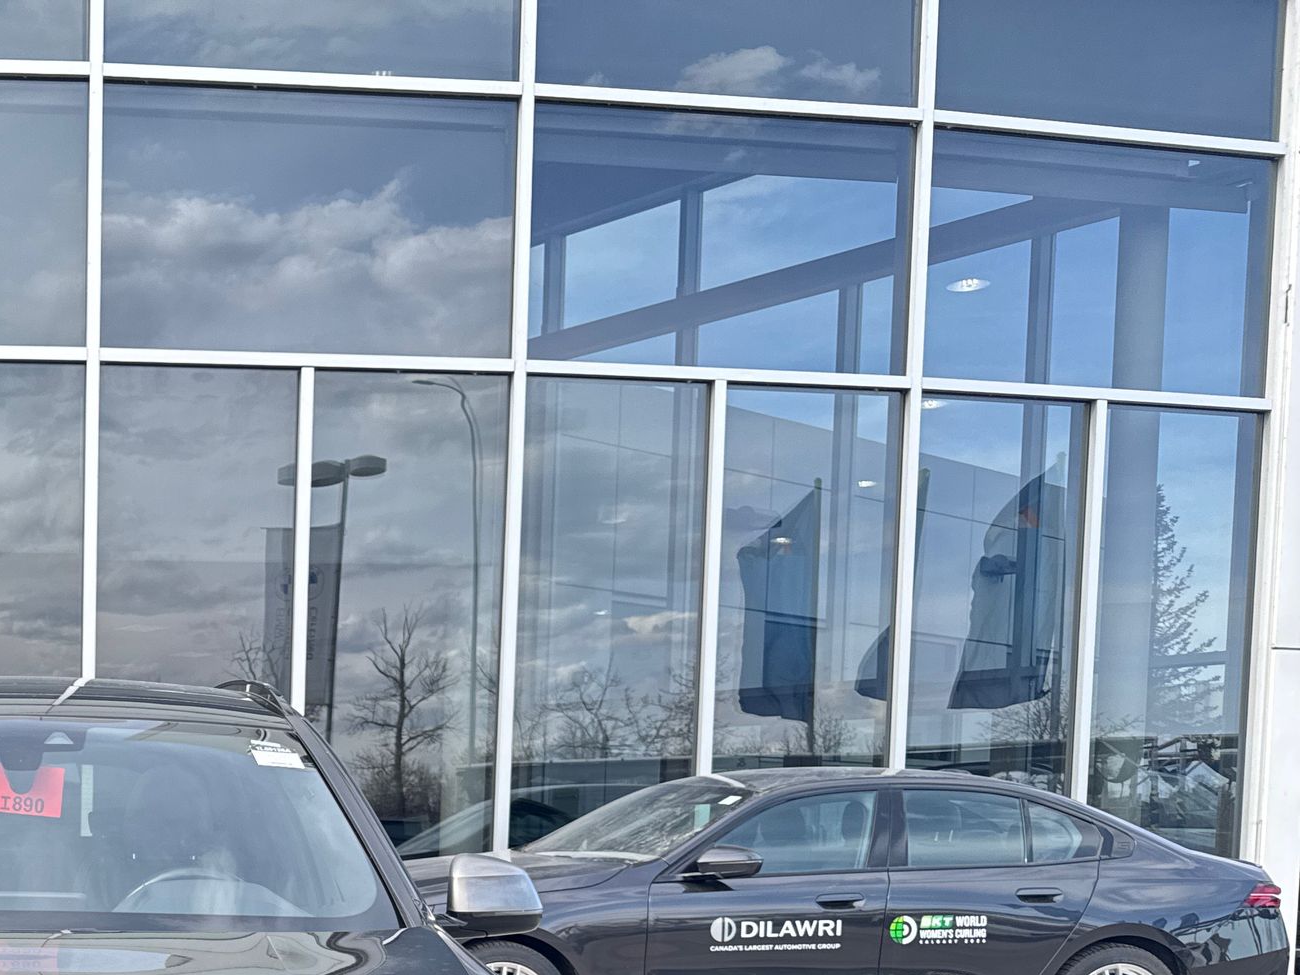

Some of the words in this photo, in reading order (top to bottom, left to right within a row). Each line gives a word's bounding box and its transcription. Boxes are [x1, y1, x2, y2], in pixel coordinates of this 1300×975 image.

[955, 915, 988, 927] WORLD
[740, 919, 843, 938] DILAWRI
[919, 928, 954, 939] WOMEN'S
[955, 928, 987, 939] CURLING
[709, 943, 743, 952] CANADA'S
[744, 943, 773, 952] LARGEST
[774, 943, 816, 951] AUTOMOTIVE
[817, 942, 841, 950] GROUP
